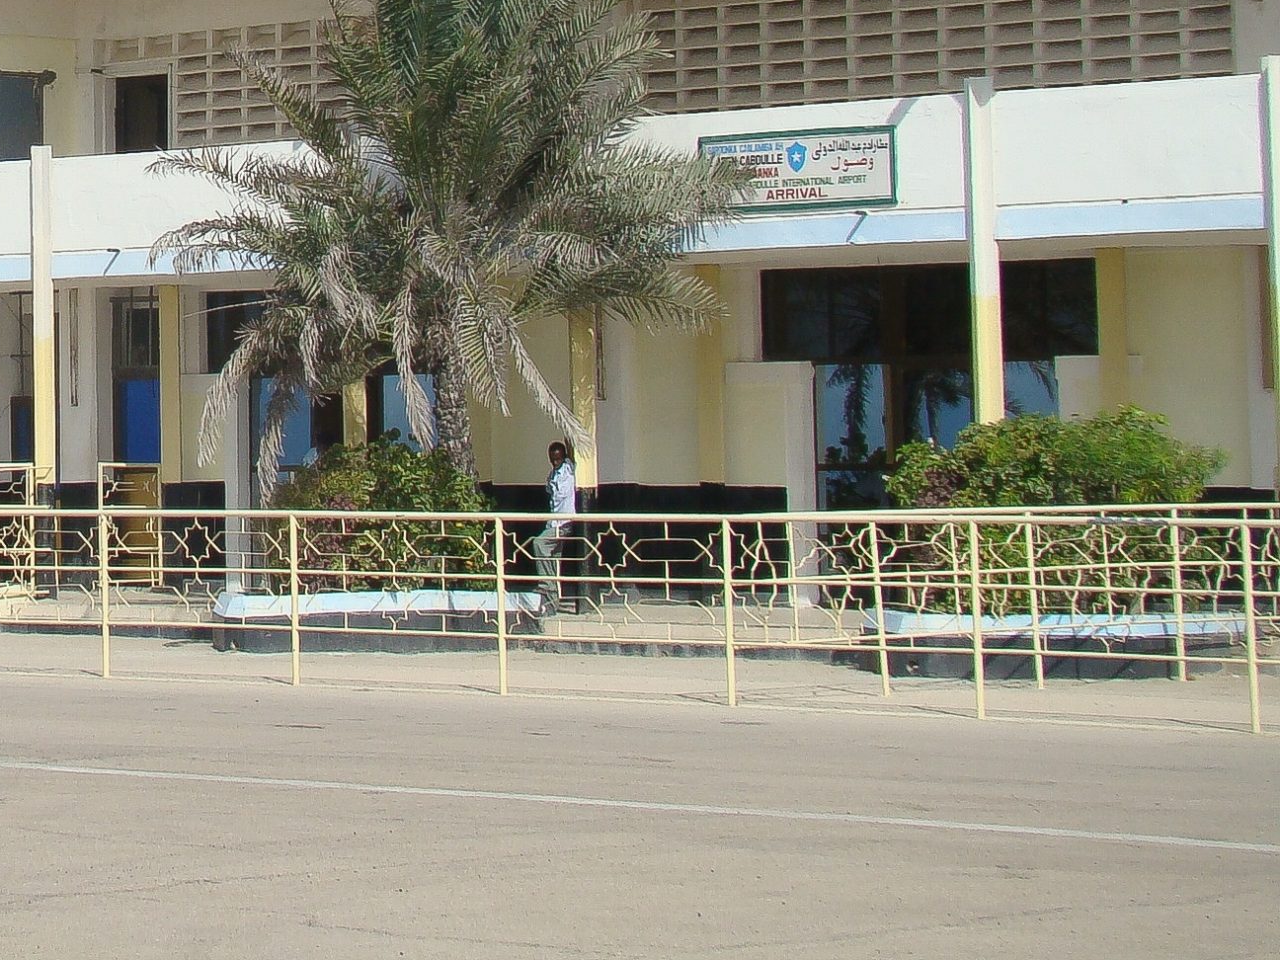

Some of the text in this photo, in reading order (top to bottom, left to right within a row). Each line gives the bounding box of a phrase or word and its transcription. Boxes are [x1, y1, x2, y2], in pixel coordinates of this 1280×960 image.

[782, 177, 834, 187] INTERNATIONAL
[838, 175, 866, 184] AIRPORT
[766, 187, 828, 200] ARRIVAL
